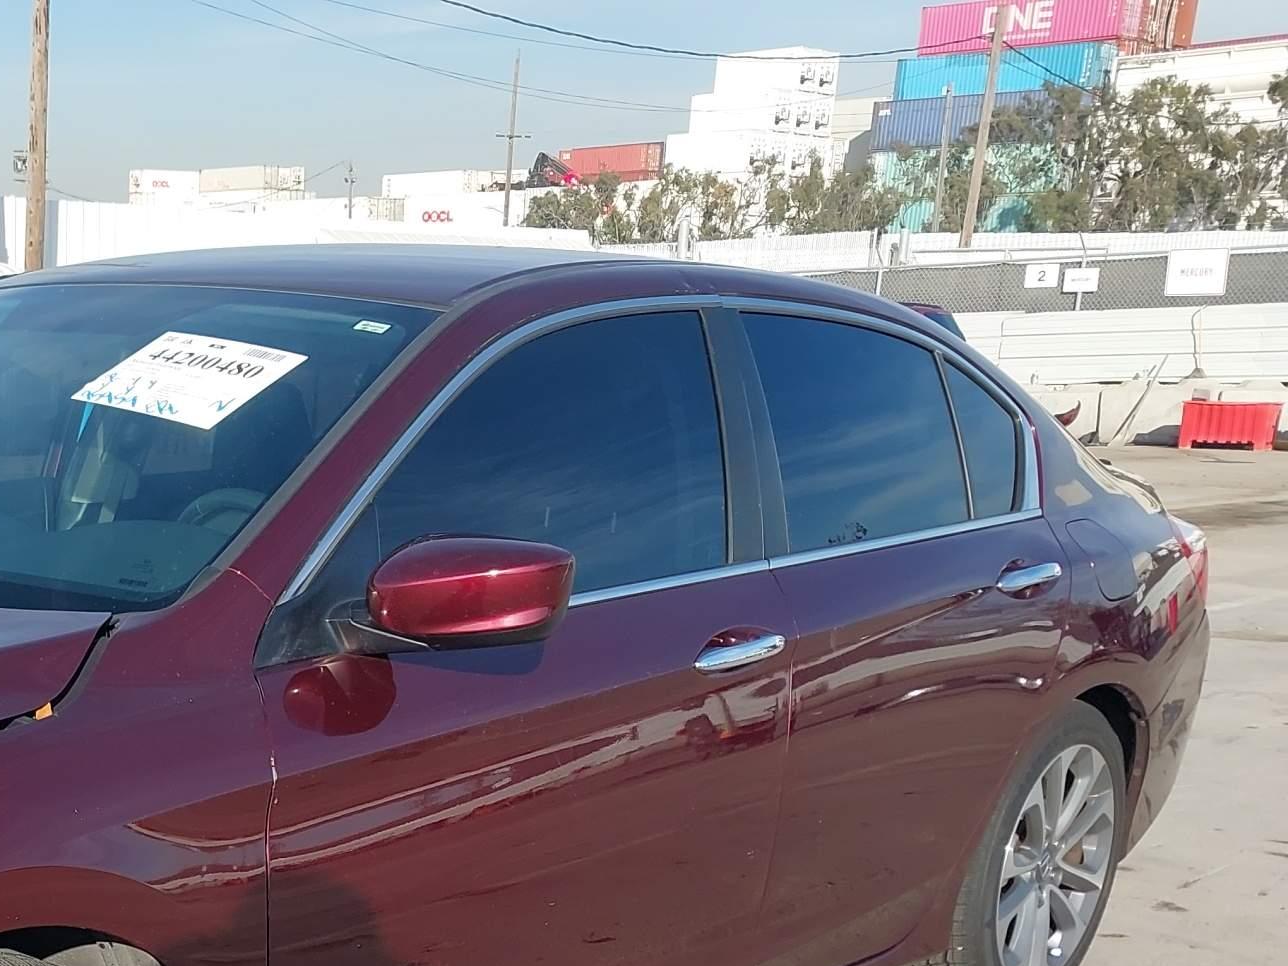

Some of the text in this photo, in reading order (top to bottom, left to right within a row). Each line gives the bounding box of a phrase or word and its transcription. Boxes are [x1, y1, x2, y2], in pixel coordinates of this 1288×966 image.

[422, 210, 454, 222] OOCL
[1038, 271, 1046, 281] 2
[149, 348, 264, 378] 44200480
